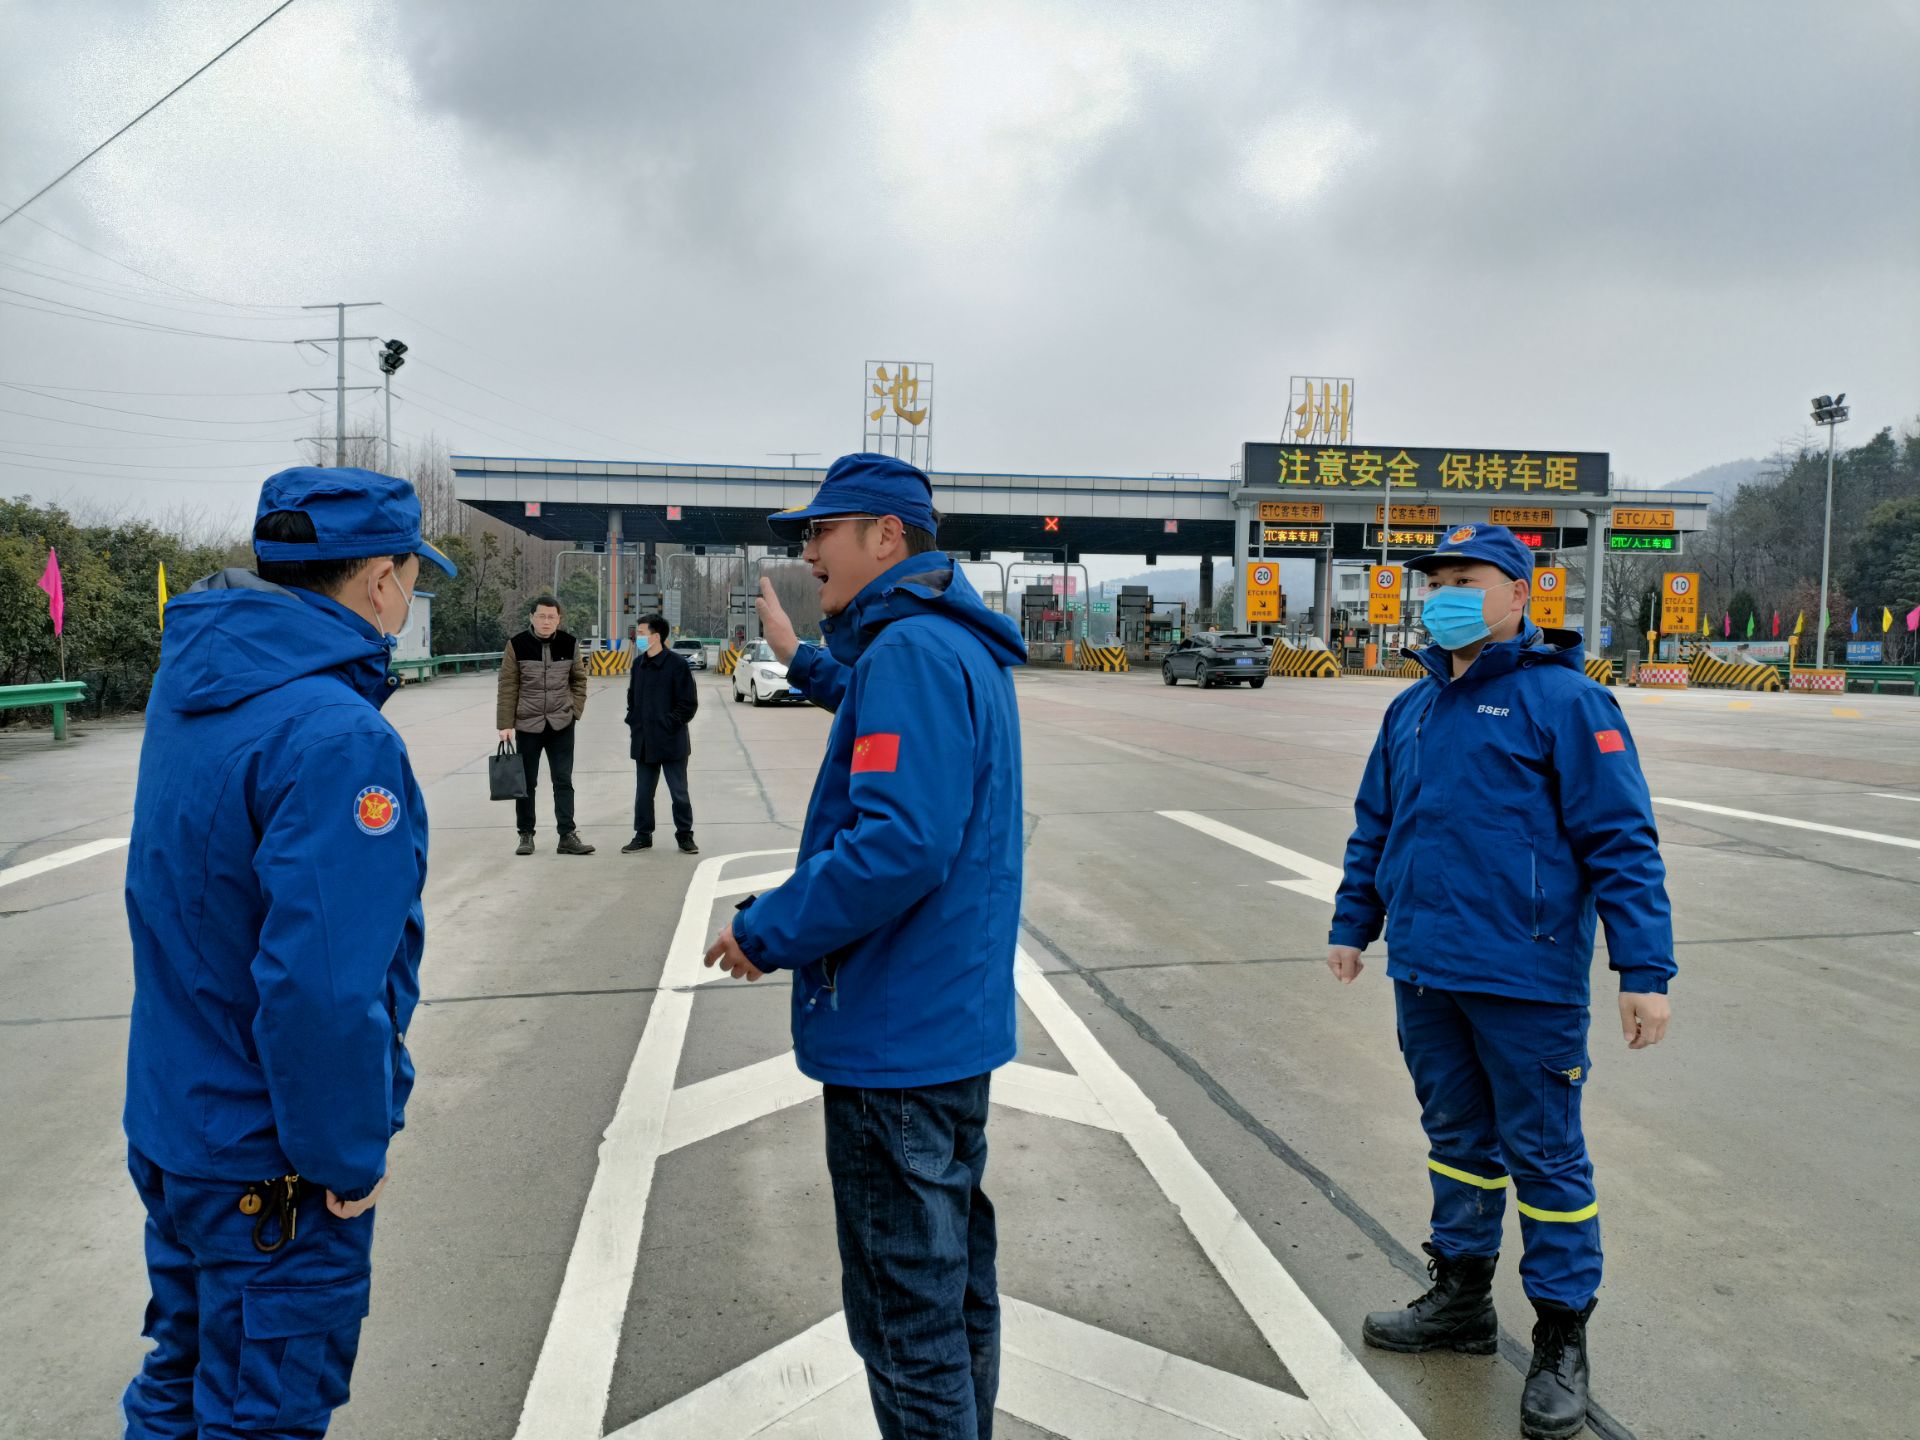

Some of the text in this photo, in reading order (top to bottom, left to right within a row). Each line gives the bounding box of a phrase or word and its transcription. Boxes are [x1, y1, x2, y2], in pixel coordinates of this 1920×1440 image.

[870, 365, 1349, 442] 池 州
[1278, 449, 1578, 491] 注意安全 保持车距
[1261, 503, 1320, 518] ETC客车专用
[1379, 507, 1437, 520] EC客车专用
[1493, 509, 1550, 522] ETC货车专用
[1616, 513, 1671, 525] ETC/人工
[1377, 531, 1434, 544] EC客车专用
[1611, 537, 1672, 549] ETC/人工车道
[1257, 571, 1269, 581] 20
[1380, 574, 1392, 584] 20
[1543, 577, 1554, 587] 10
[1675, 580, 1687, 590] 10
[1476, 704, 1511, 718] BSER
